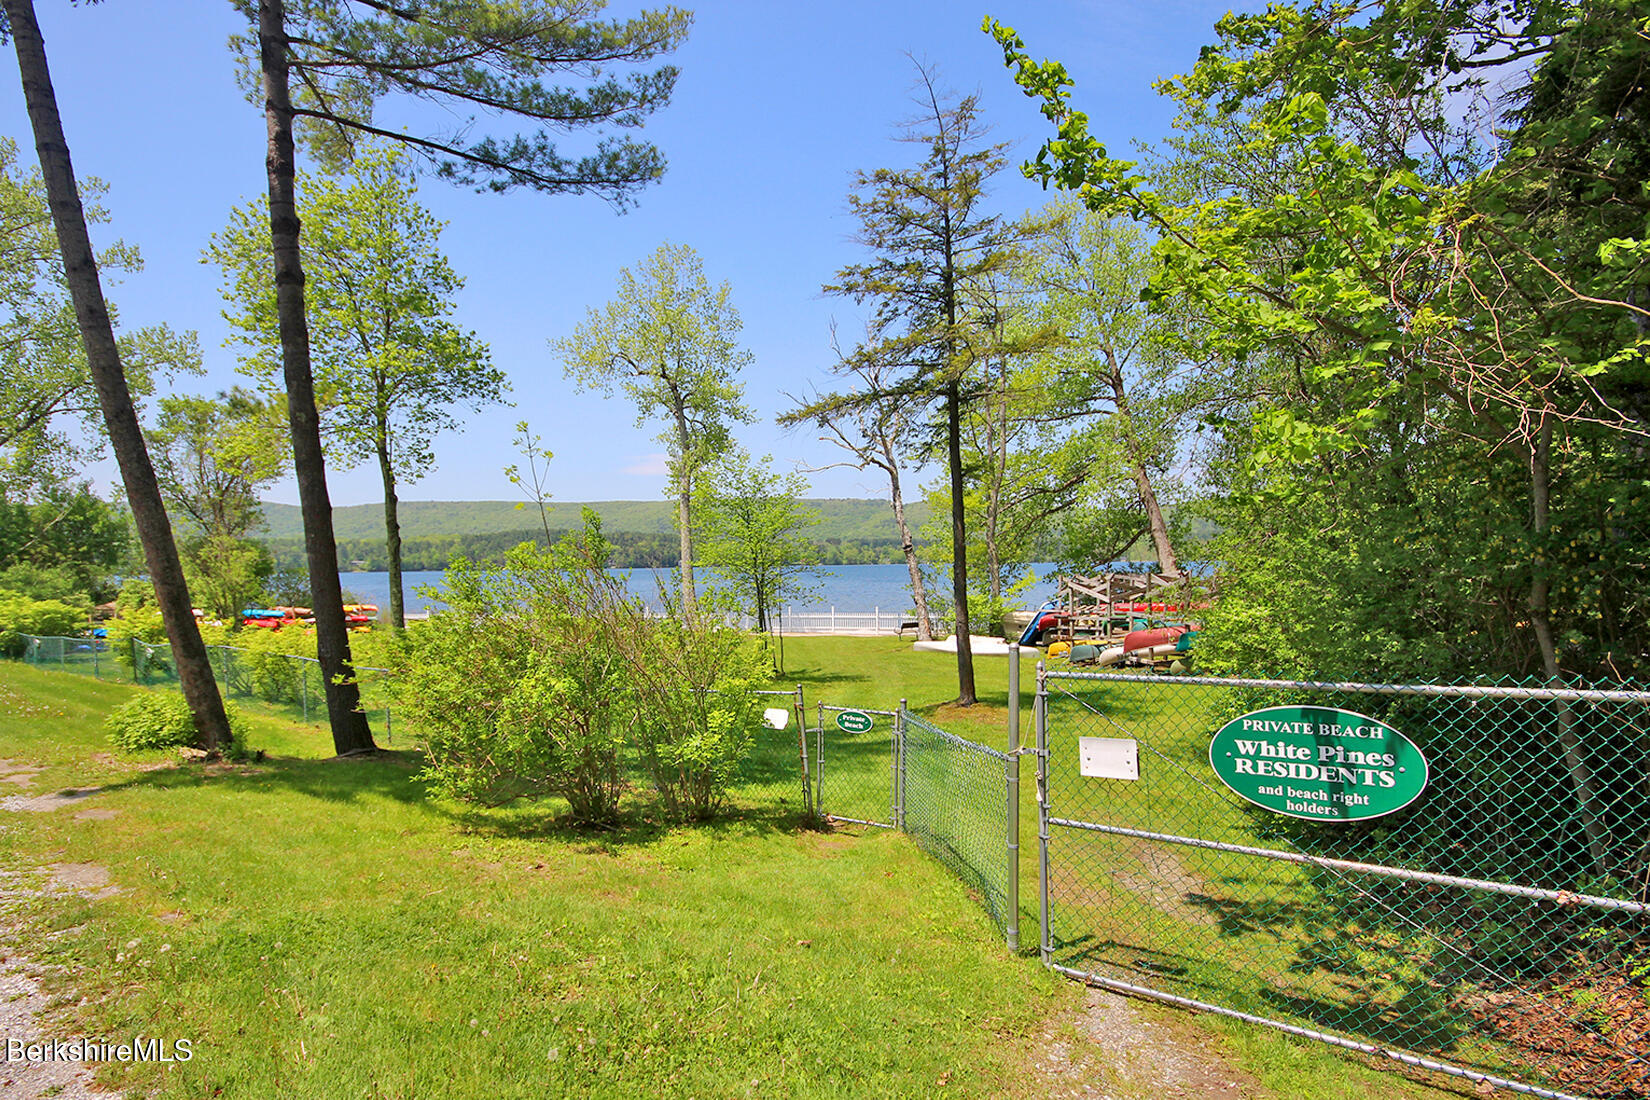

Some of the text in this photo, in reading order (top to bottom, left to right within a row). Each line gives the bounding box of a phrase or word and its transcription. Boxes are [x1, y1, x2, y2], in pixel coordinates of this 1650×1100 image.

[1242, 719, 1384, 739] PRIVATE BEACH
[1233, 739, 1396, 768] White Pines
[1234, 758, 1397, 788] RESIDENTS
[1258, 785, 1370, 806] and beach right
[1286, 799, 1339, 816] holders
